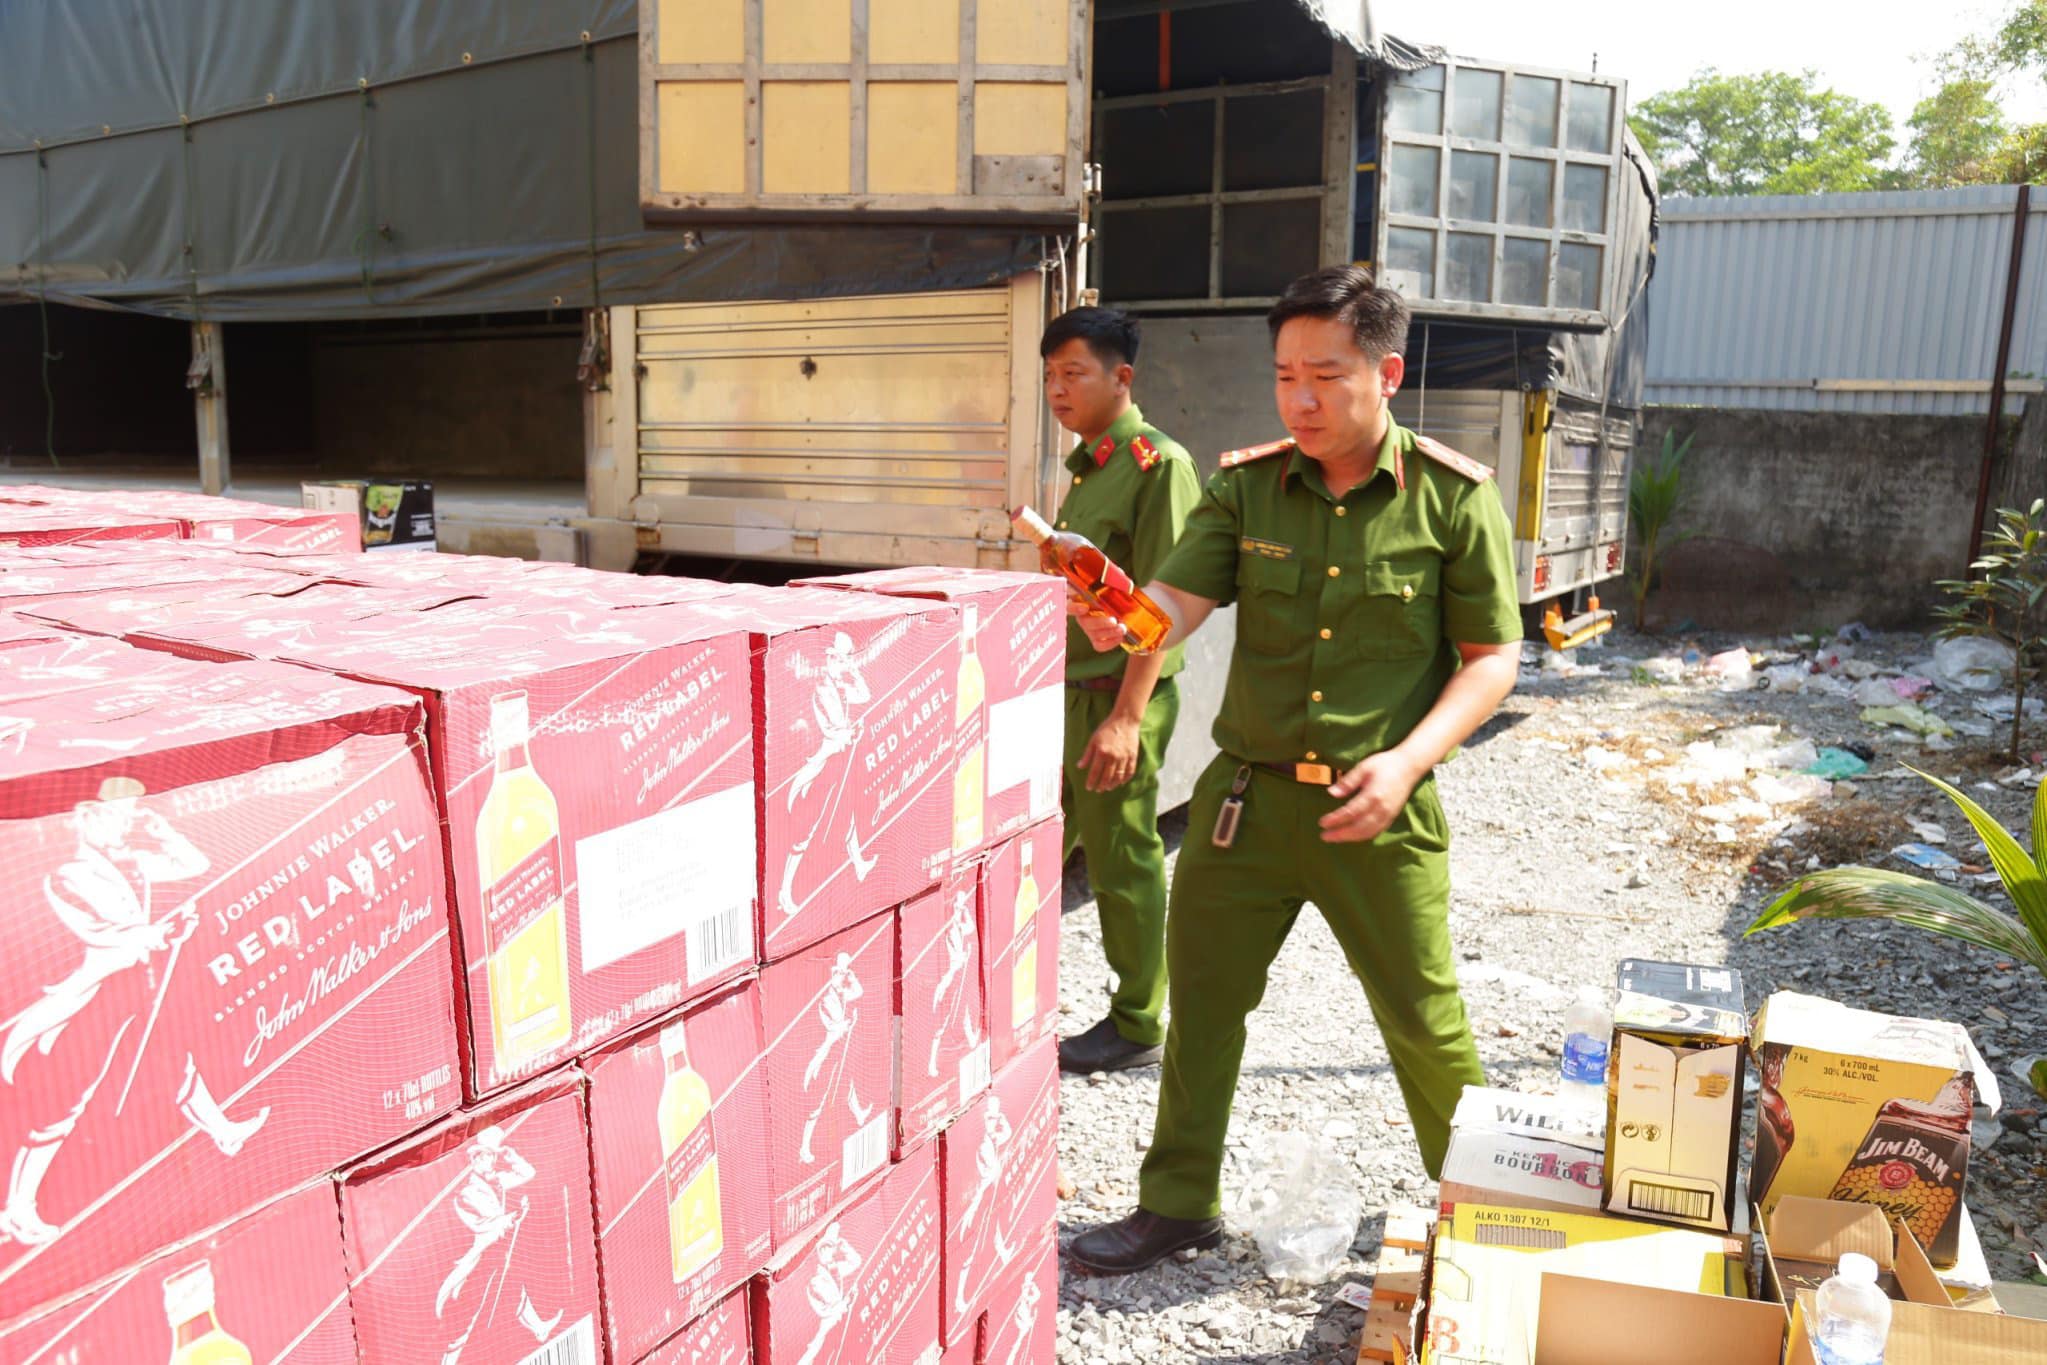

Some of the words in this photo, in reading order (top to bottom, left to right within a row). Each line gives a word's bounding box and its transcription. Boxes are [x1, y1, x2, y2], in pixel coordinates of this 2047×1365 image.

[865, 733, 899, 772] RED
[215, 855, 311, 936] JOHNNIE
[516, 866, 553, 899] LABEL
[208, 916, 292, 986] RED
[243, 992, 307, 1067] John
[305, 941, 379, 1005] Walker
[391, 895, 432, 943] Sons
[1799, 1054, 1808, 1063] kg
[1840, 1059, 1845, 1067] 6
[1853, 1061, 1867, 1070] 700
[1494, 1154, 1587, 1183] BOURBON
[1857, 1137, 1904, 1160] JIM
[1901, 1137, 1950, 1183] BEAM
[1475, 1211, 1500, 1222] ALKO
[1504, 1214, 1527, 1224] 1307
[1530, 1217, 1550, 1226] 12/1
[860, 1278, 889, 1323] RED
